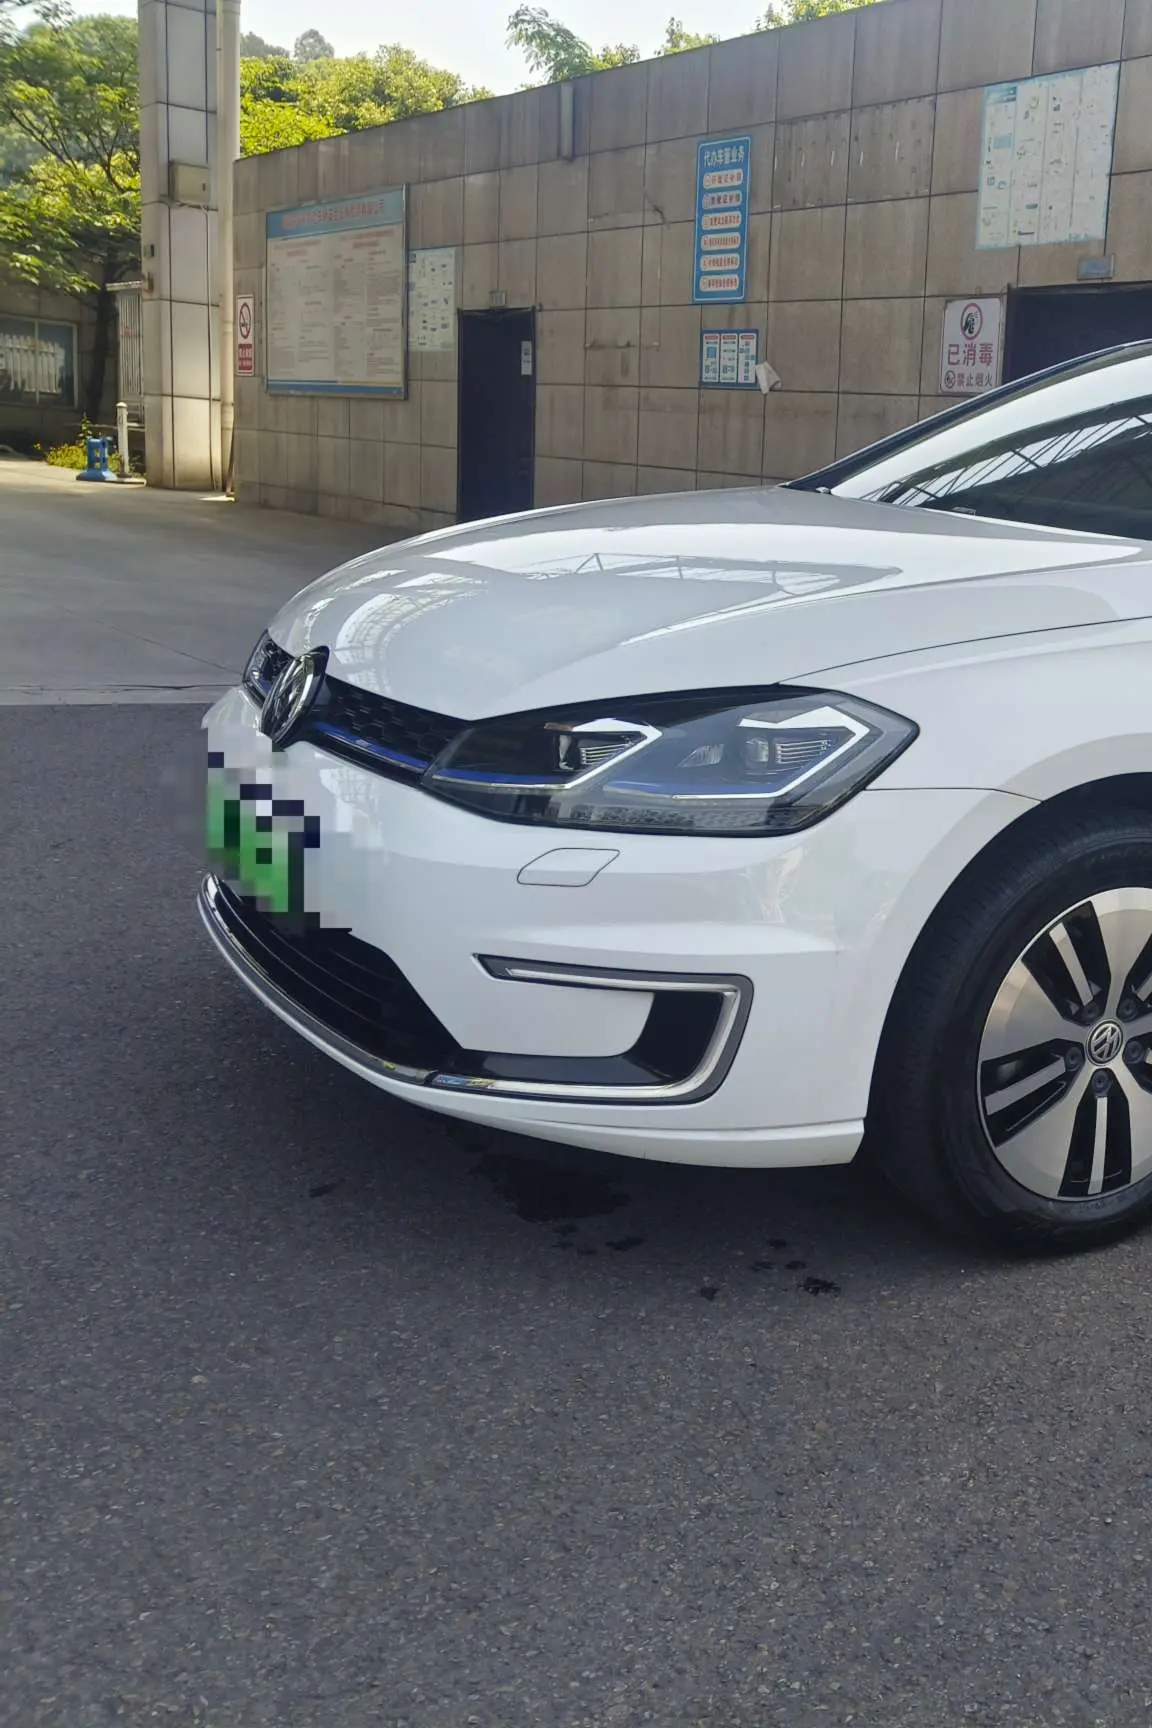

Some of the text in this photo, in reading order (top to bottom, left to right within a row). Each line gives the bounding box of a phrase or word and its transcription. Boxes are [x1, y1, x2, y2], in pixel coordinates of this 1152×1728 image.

[947, 342, 993, 367] 已消毒
[957, 373, 992, 387] 禁止烟火
